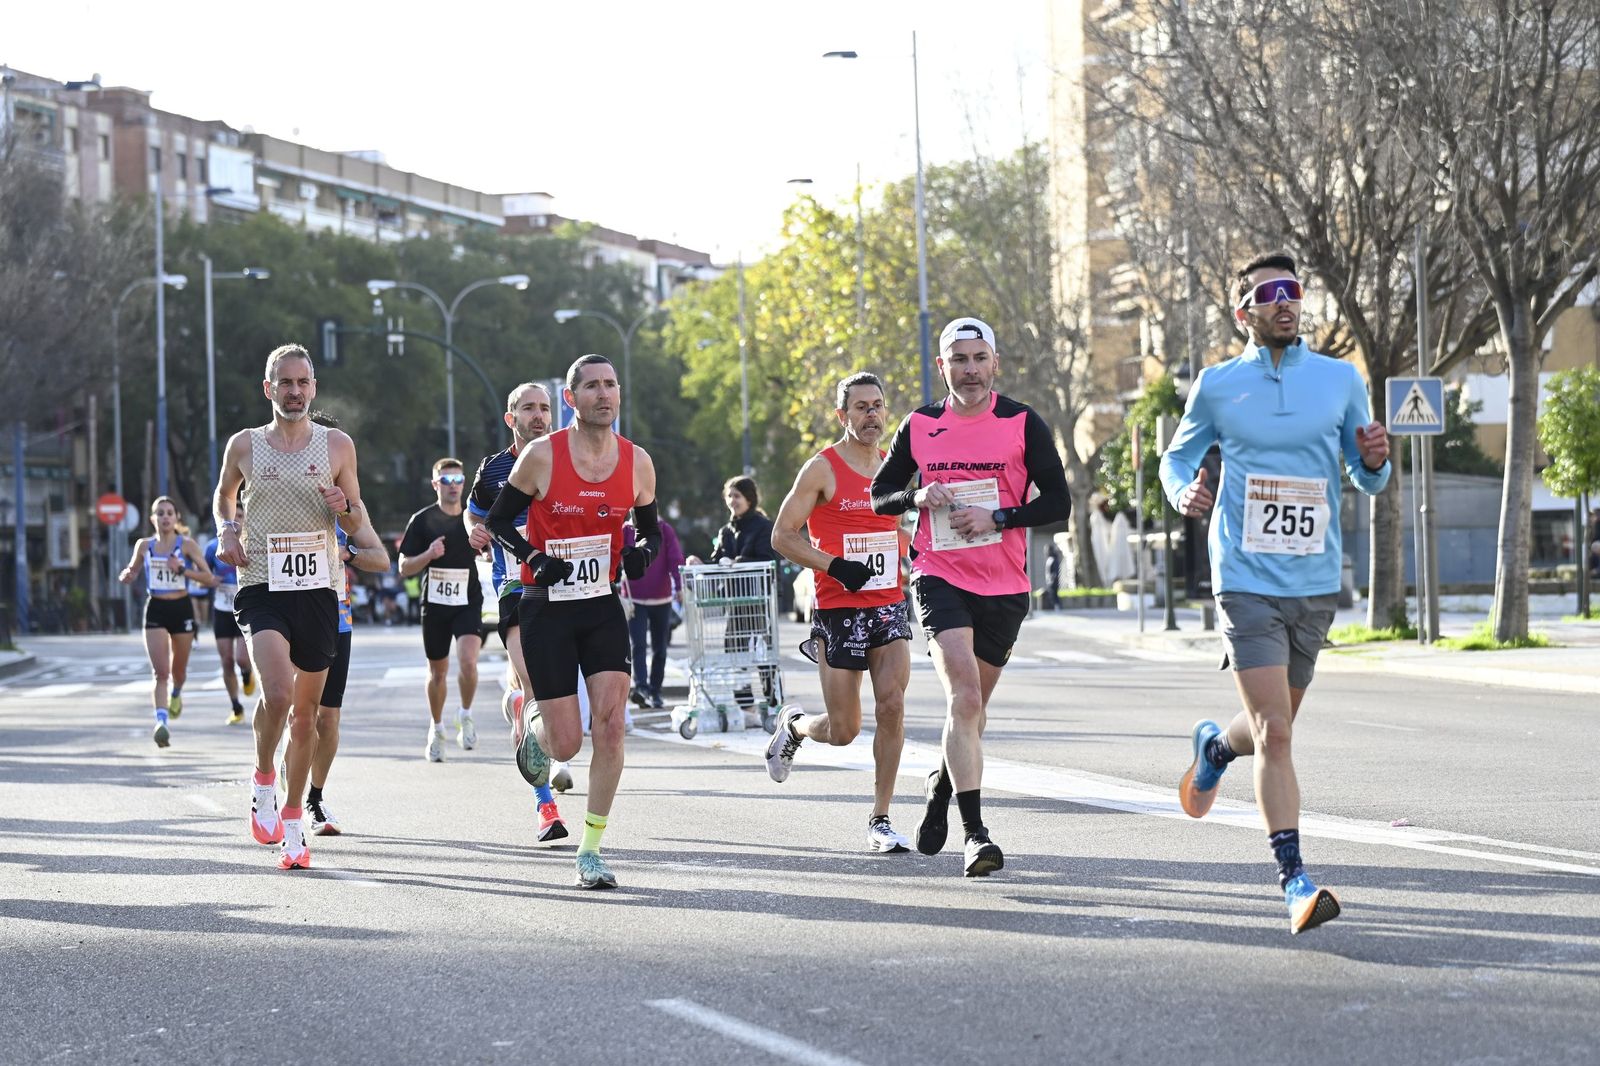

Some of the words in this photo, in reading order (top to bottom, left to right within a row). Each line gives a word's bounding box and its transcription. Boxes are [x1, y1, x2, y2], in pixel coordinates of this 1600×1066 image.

[926, 461, 1007, 472] TABLERUNNERS
[1249, 479, 1279, 502] XLII
[559, 504, 585, 514] califas
[1262, 503, 1315, 538] 255
[270, 537, 292, 553] XLII
[549, 543, 572, 560] XLII
[847, 537, 868, 554] XLII
[282, 552, 317, 577] 405
[563, 558, 600, 586] 240
[436, 581, 460, 597] 464
